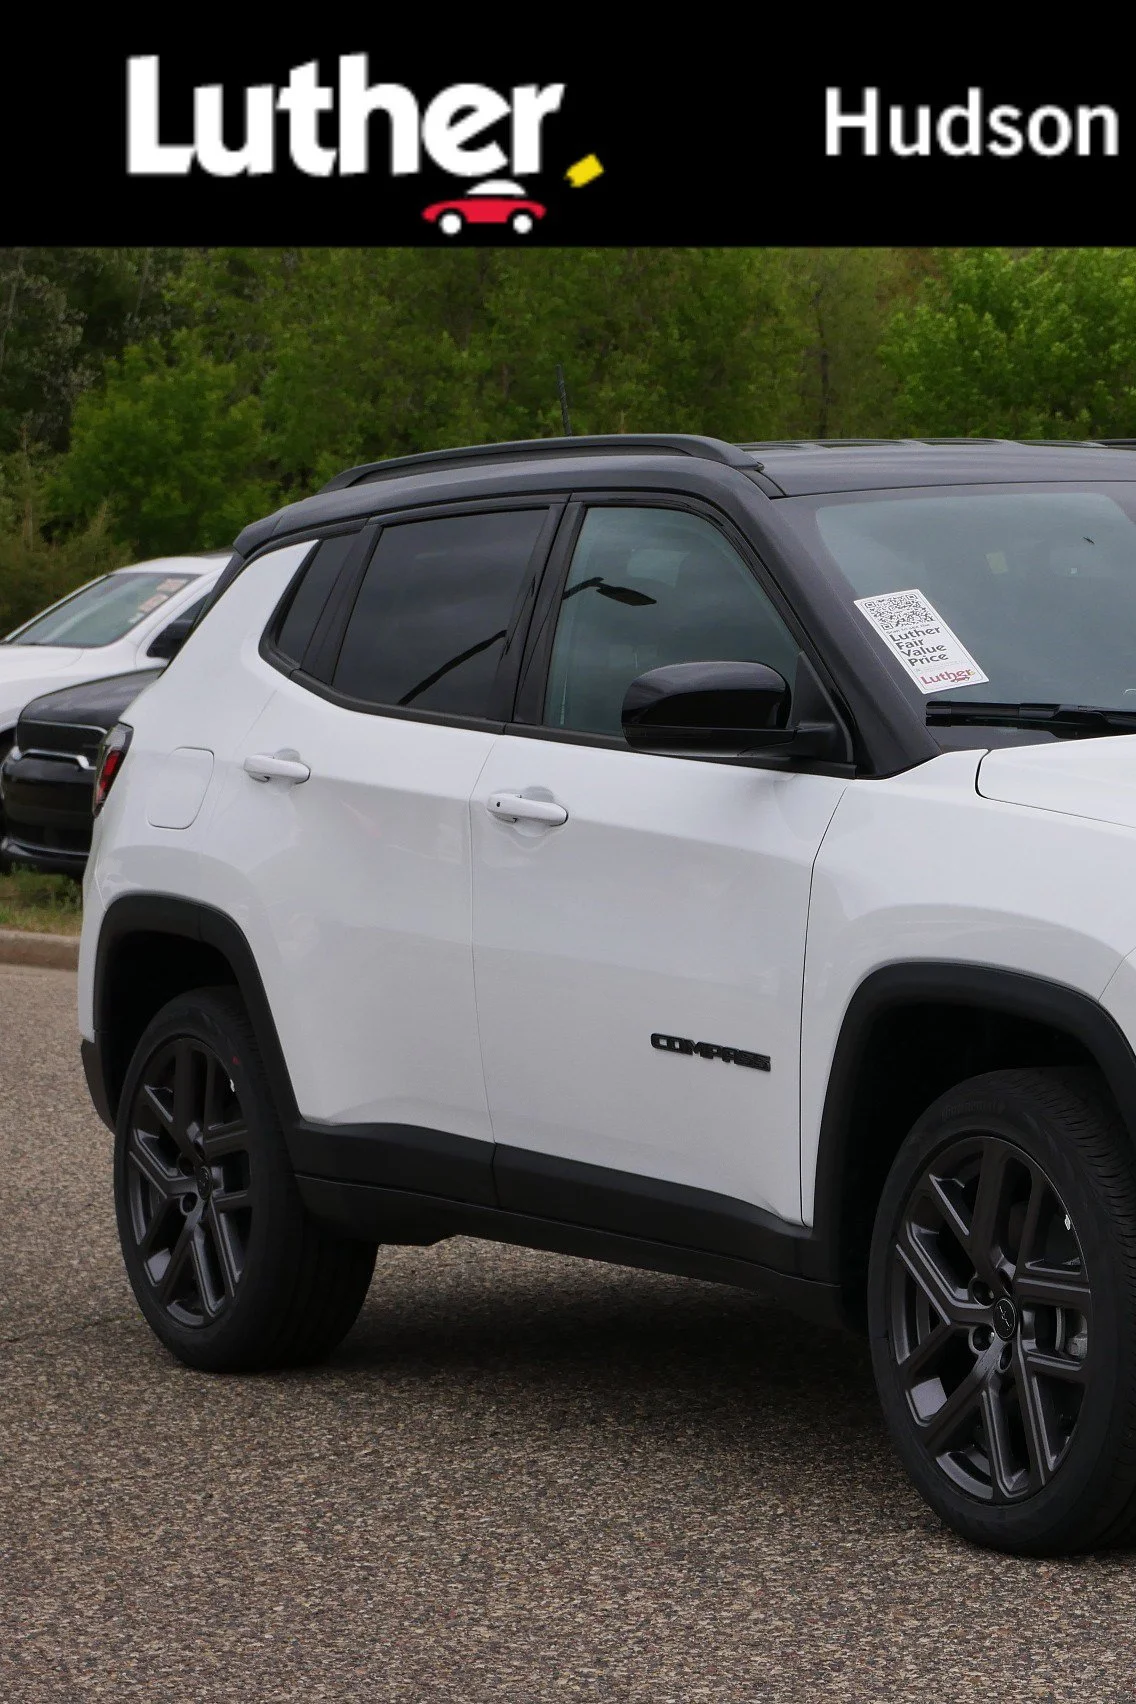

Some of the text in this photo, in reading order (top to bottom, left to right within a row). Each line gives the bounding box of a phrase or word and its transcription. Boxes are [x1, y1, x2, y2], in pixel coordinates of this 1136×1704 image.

[889, 627, 941, 642] Luther
[895, 638, 924, 650] Fair
[901, 644, 947, 657] Value
[908, 653, 949, 667] Price
[920, 668, 973, 685] Luther
